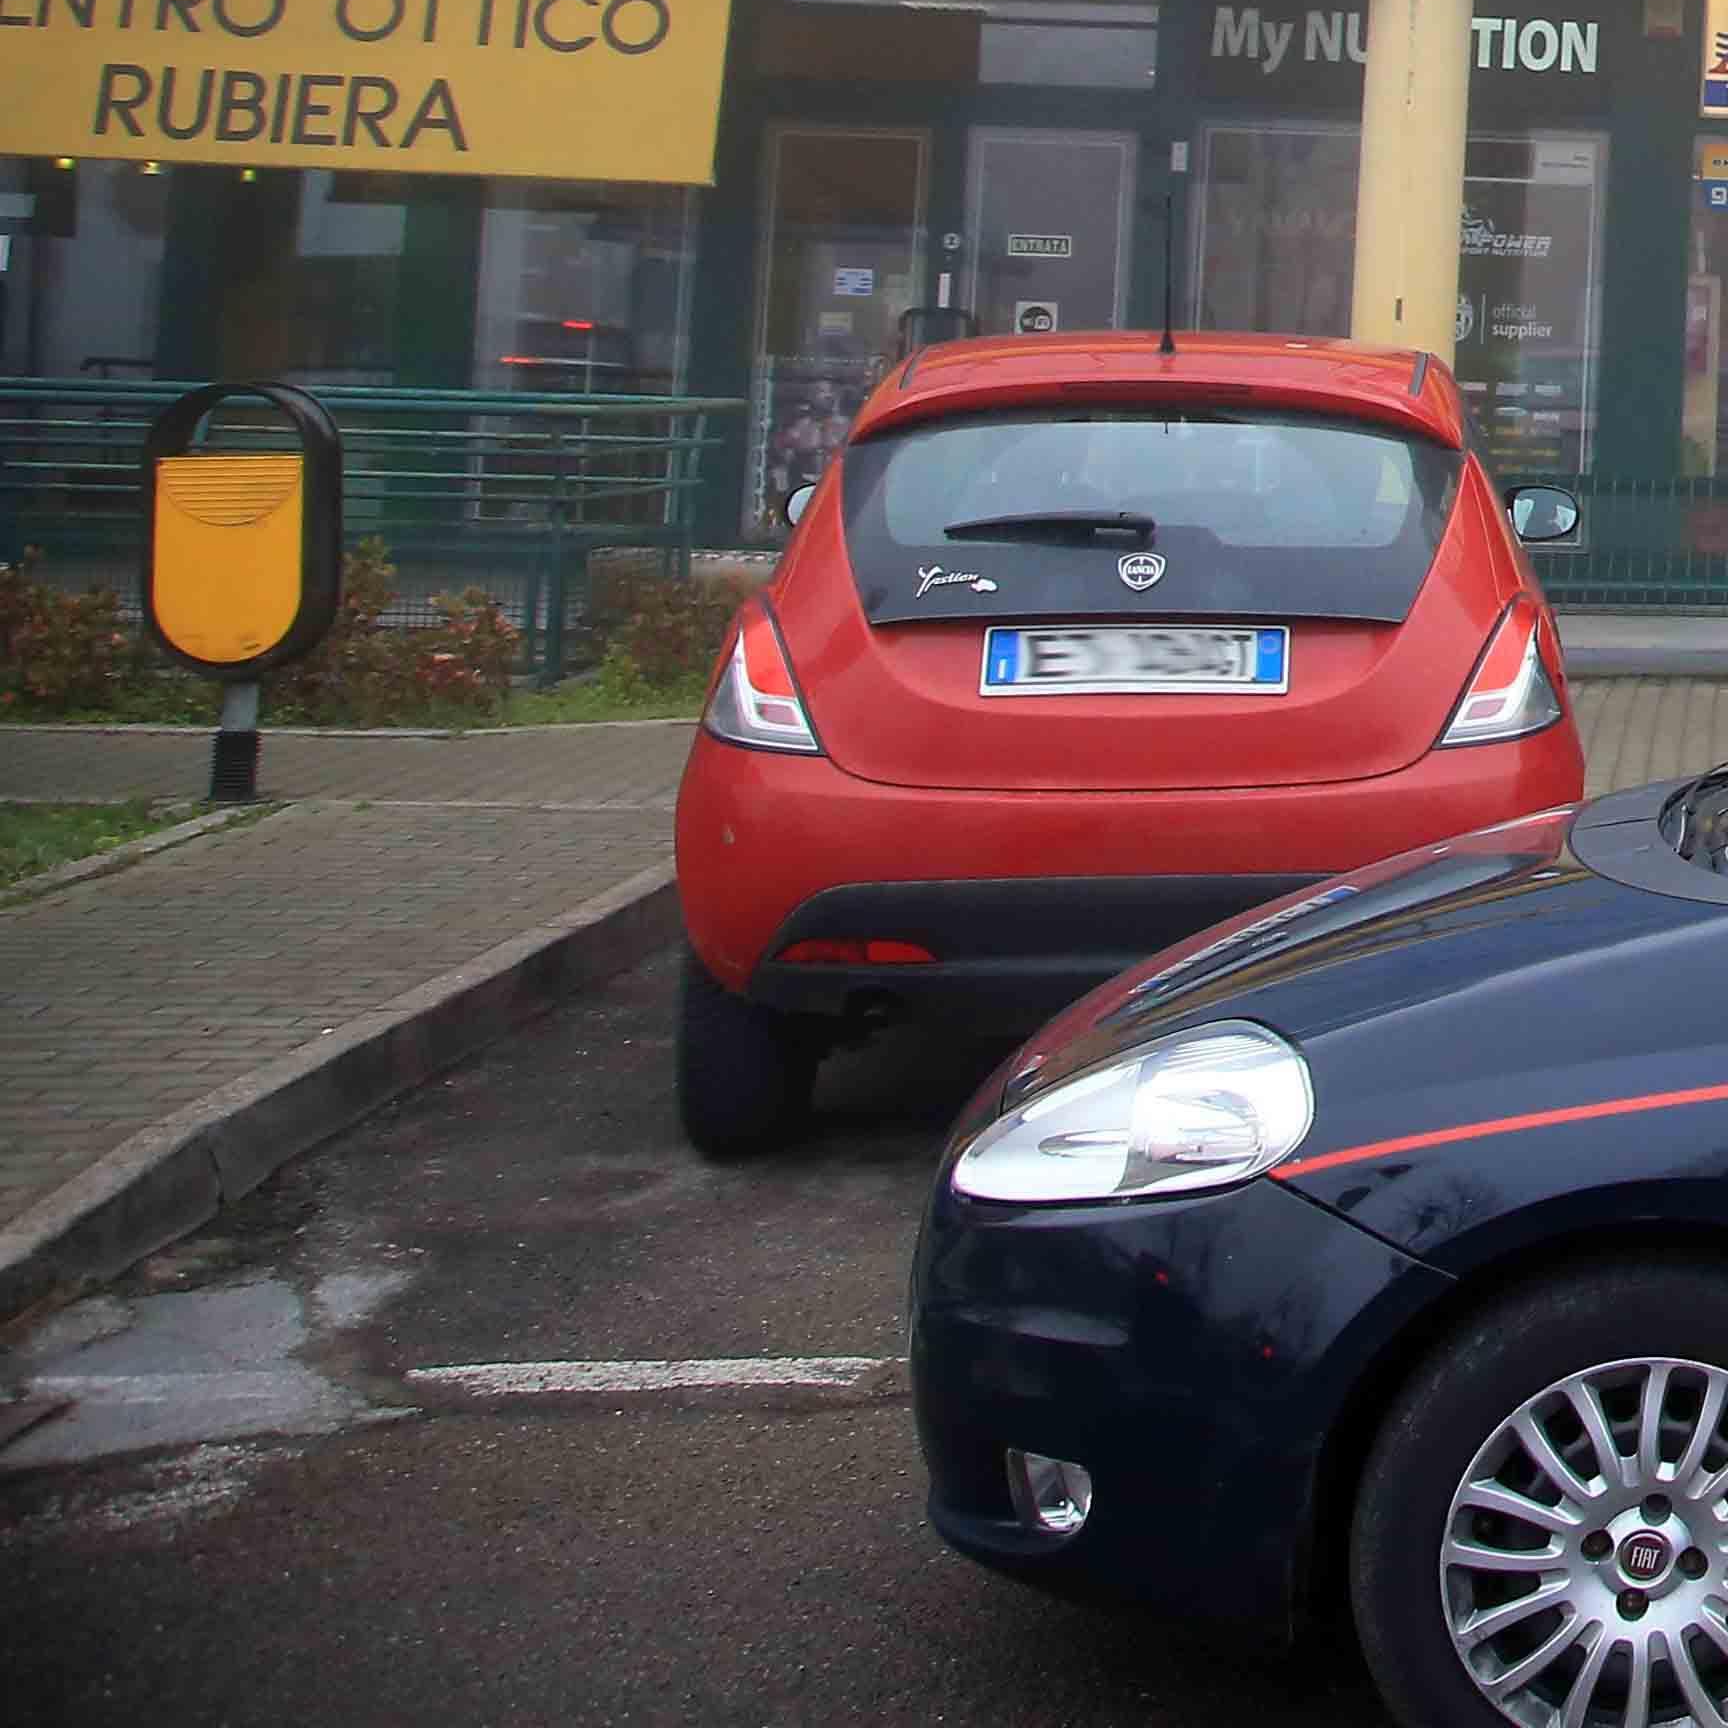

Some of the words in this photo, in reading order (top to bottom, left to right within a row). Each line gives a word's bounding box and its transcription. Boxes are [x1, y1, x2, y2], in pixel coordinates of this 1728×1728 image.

[1210, 5, 1296, 74] My
[93, 62, 469, 152] RUBIERA
[1491, 322, 1553, 339] supplier
[1631, 1546, 1661, 1569] FIAT
